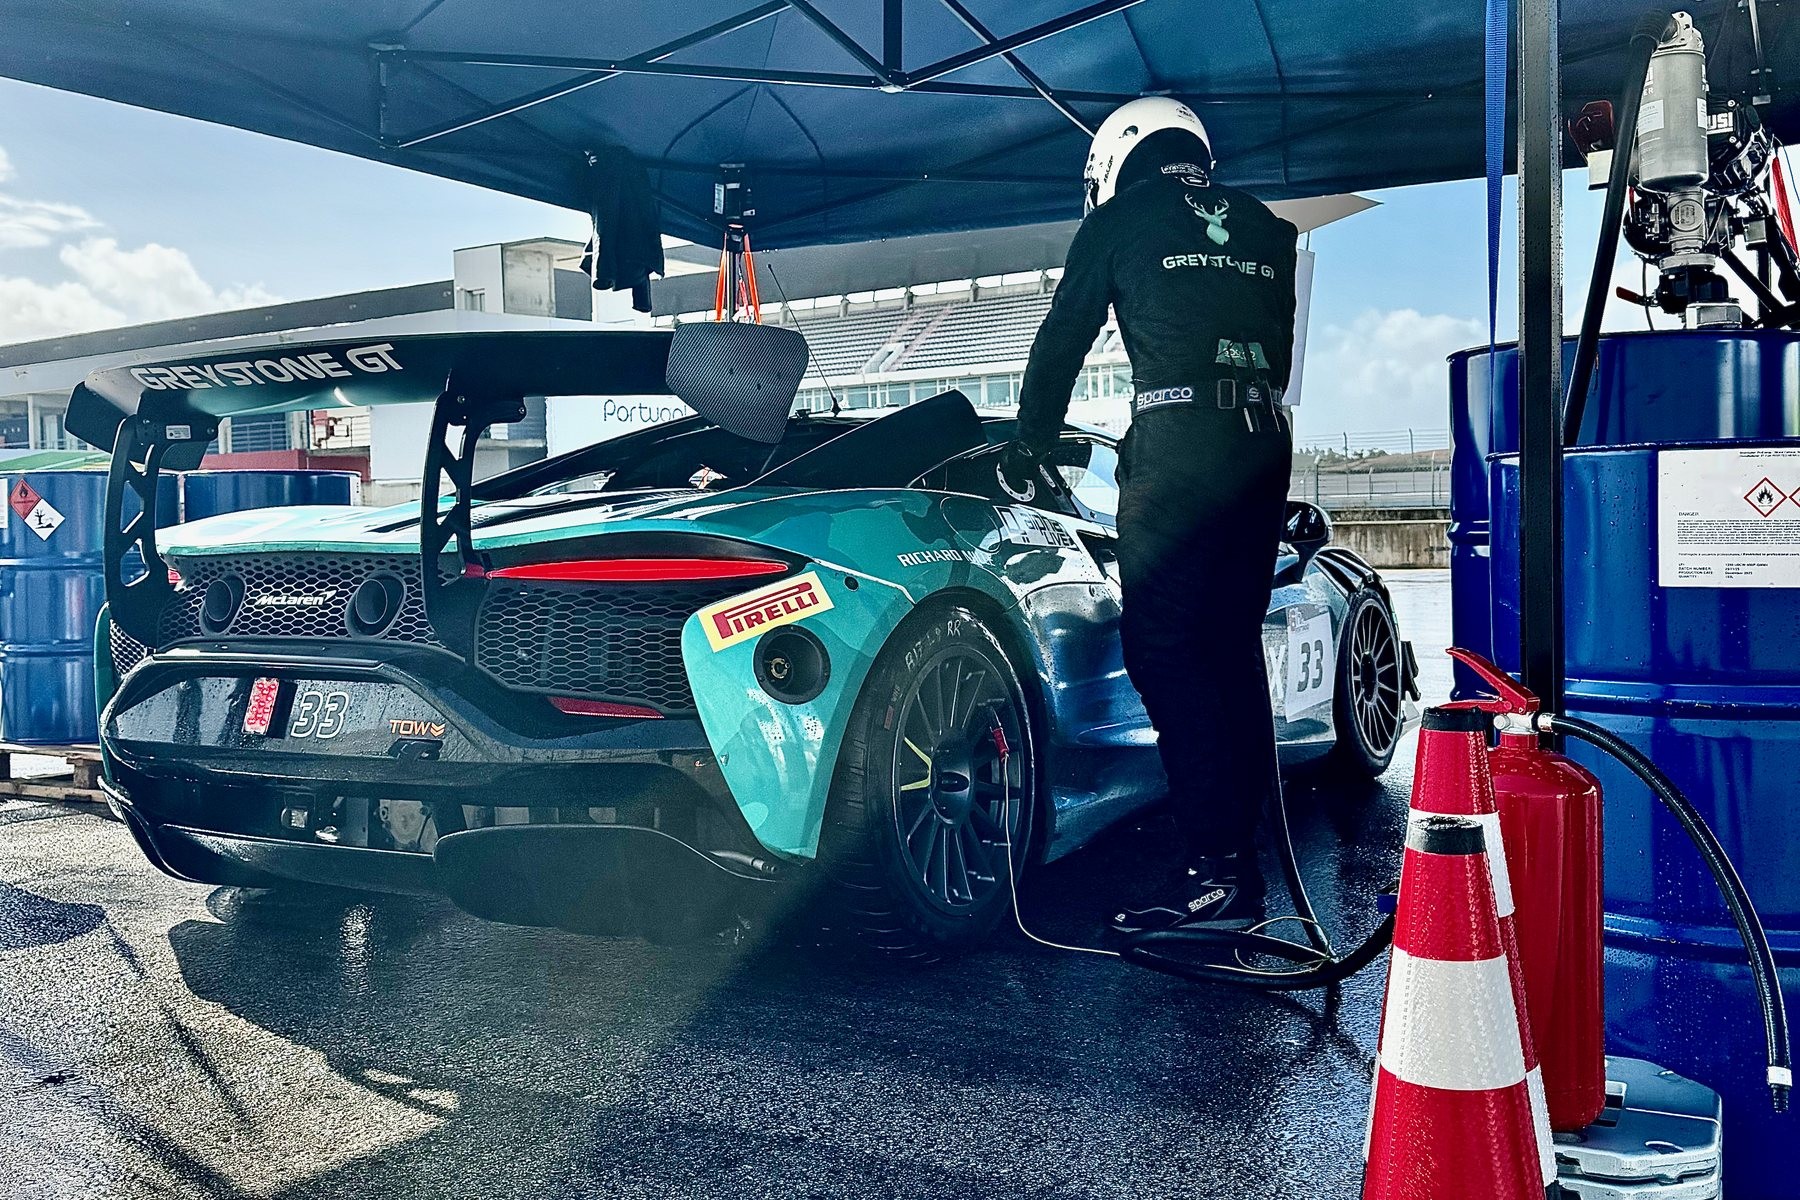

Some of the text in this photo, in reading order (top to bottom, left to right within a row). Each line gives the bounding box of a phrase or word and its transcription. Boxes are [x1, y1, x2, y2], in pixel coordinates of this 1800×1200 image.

[130, 343, 403, 391] GREYSTONE GT
[1136, 387, 1193, 411] sparco
[897, 550, 963, 567] RICHARD
[254, 595, 325, 606] McLaren
[712, 582, 819, 640] PIRELLI
[947, 619, 961, 637] RR
[1296, 639, 1324, 693] 33
[290, 691, 350, 739] 33
[389, 719, 430, 736] TOW
[1188, 889, 1226, 912] sparco
